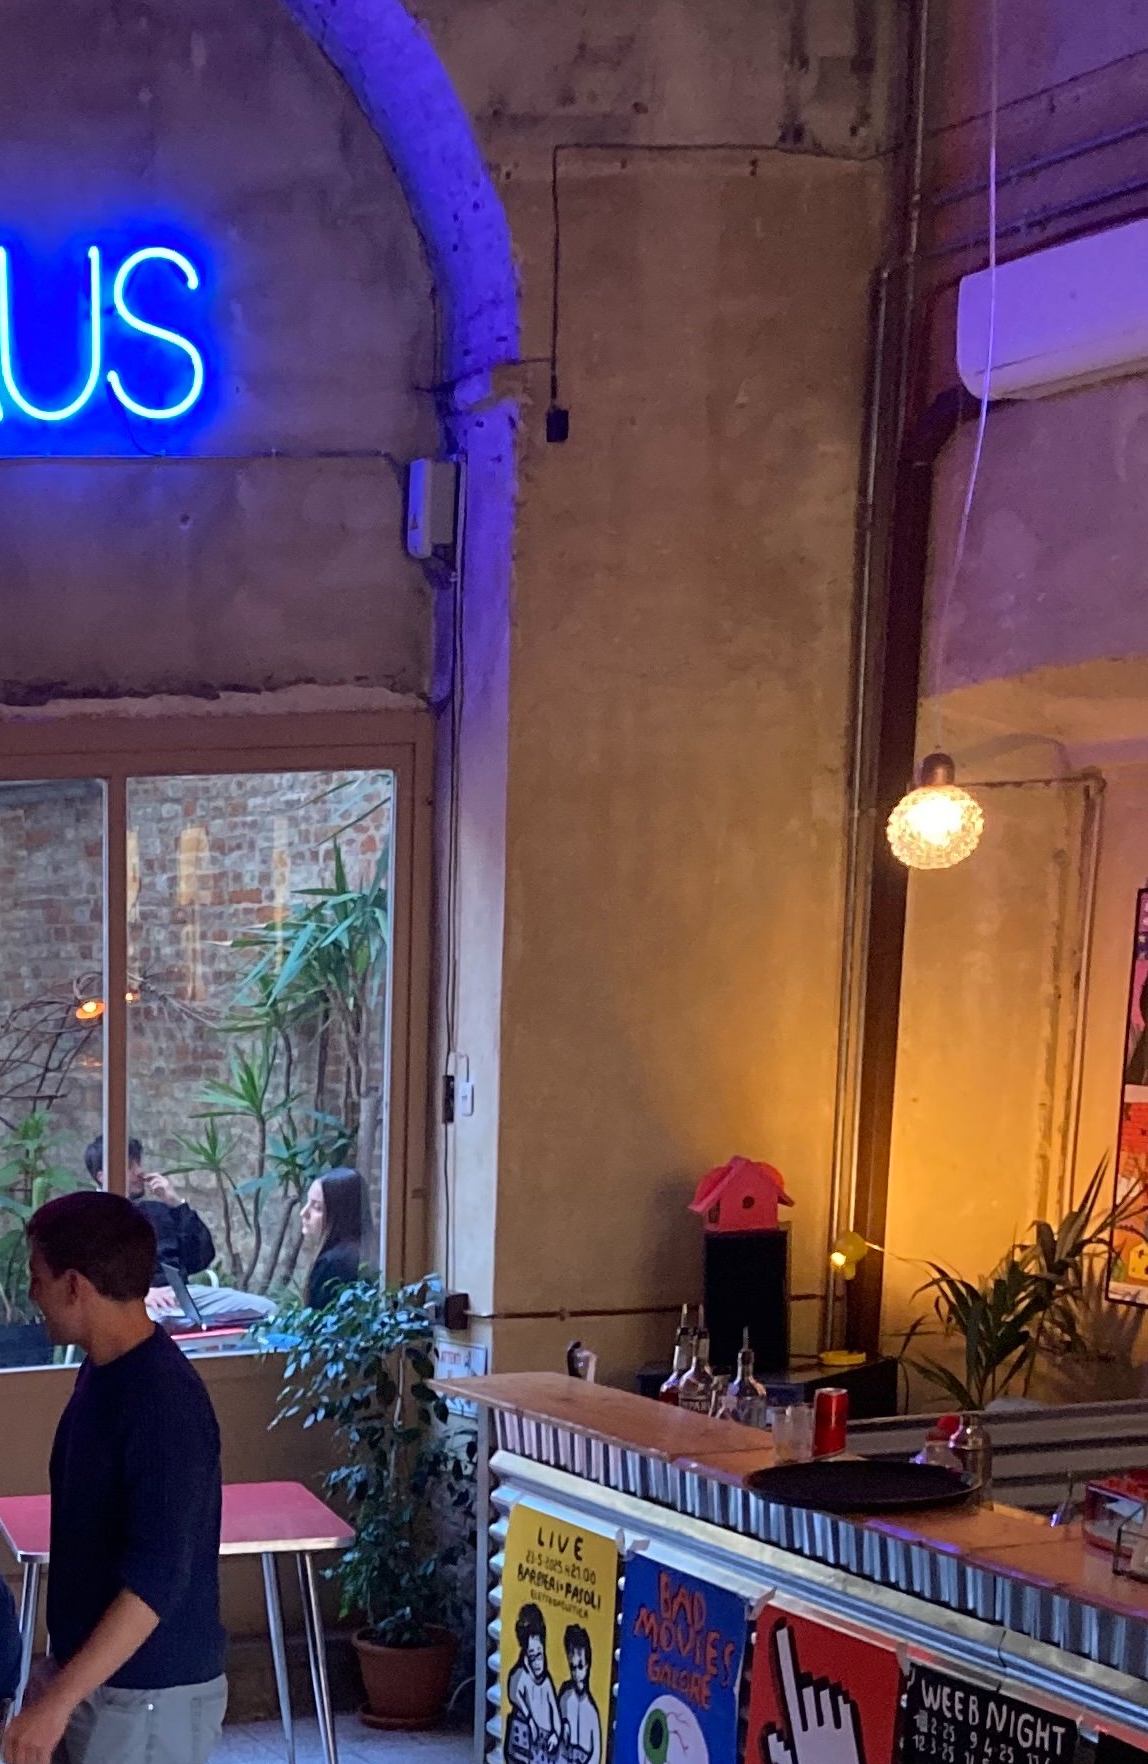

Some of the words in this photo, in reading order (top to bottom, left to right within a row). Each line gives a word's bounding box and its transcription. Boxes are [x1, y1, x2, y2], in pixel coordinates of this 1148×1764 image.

[537, 1526, 584, 1561] LIVE
[659, 1570, 707, 1630] BAD
[633, 1604, 736, 1687] MOVIES
[921, 1679, 980, 1726] WEEB
[986, 1701, 1066, 1755] NIGHT
